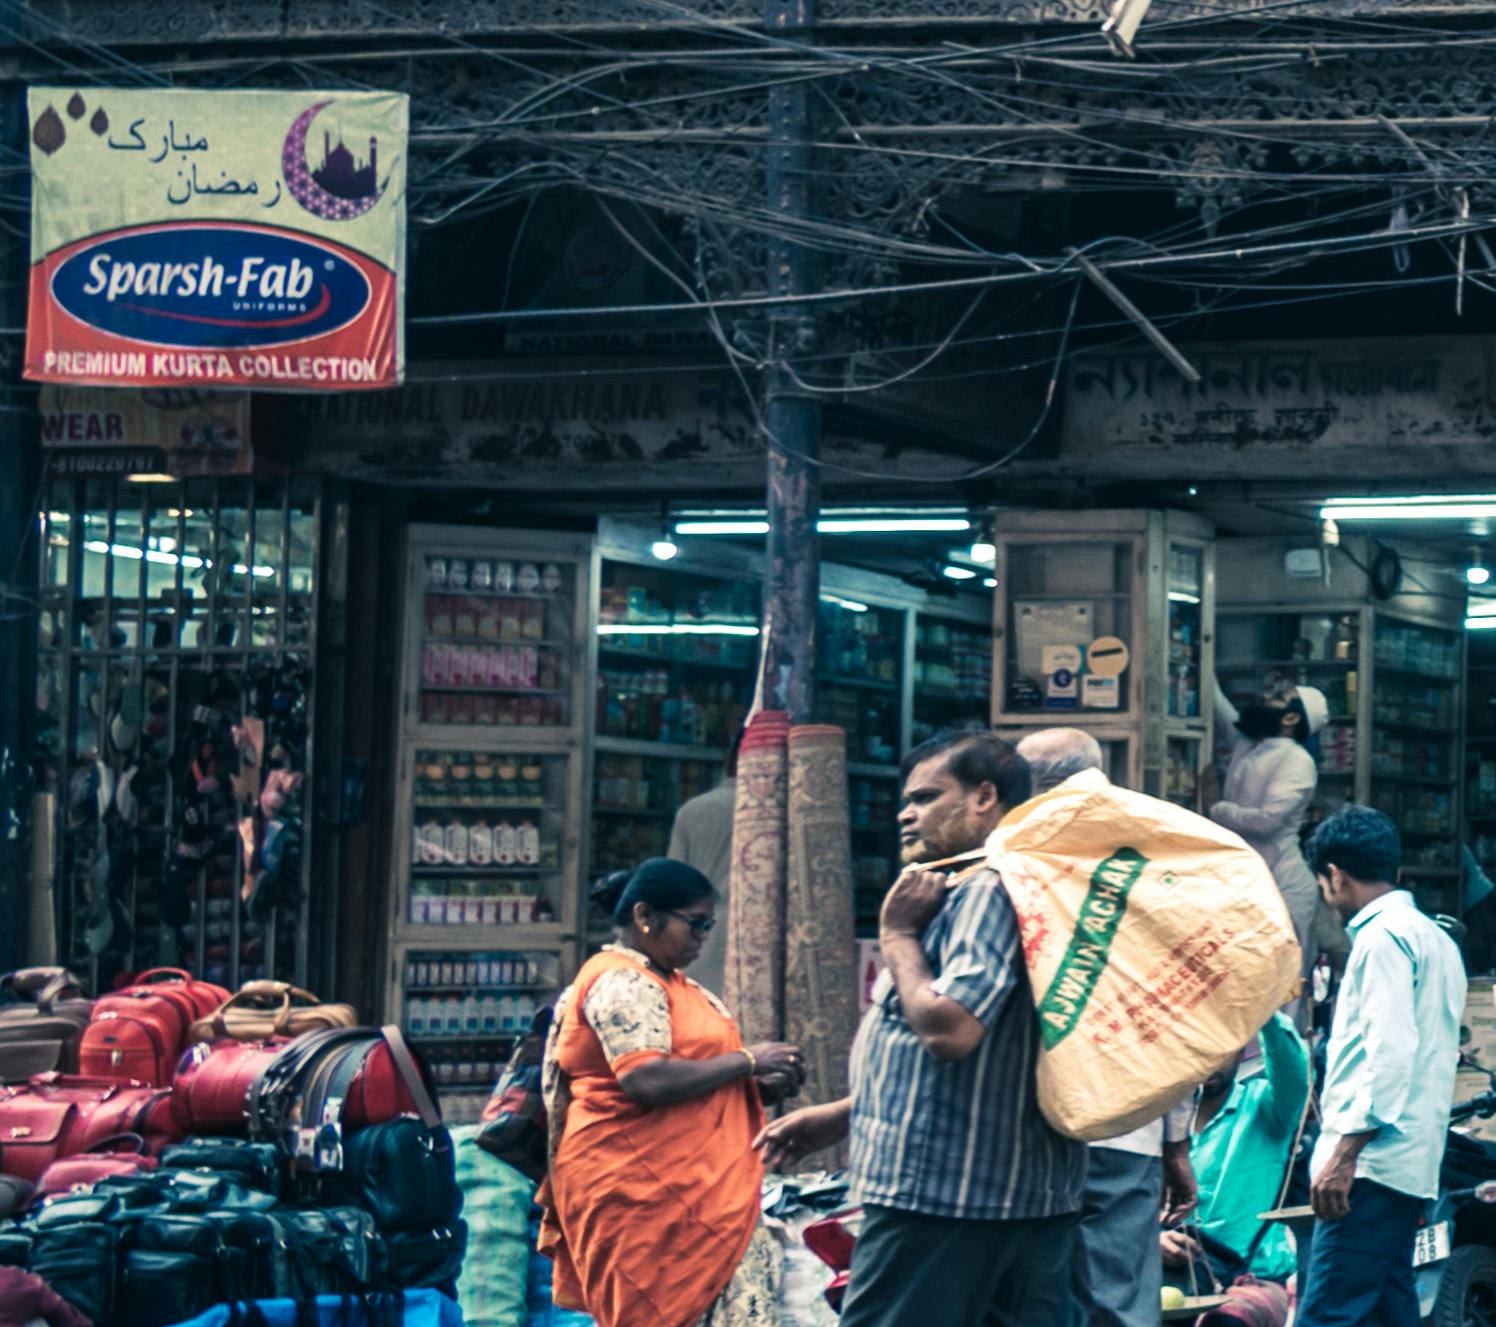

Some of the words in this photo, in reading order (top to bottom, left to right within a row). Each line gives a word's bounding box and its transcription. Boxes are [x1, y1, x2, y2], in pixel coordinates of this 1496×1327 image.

[167, 163, 282, 207] رمضان
[83, 253, 314, 301] Sparsh-Fab
[233, 301, 307, 312] UNIFORMS
[43, 351, 145, 377] PREMIUM
[153, 353, 234, 378] KURTA
[240, 355, 377, 382] COLLECTION
[41, 413, 124, 441] WEAR
